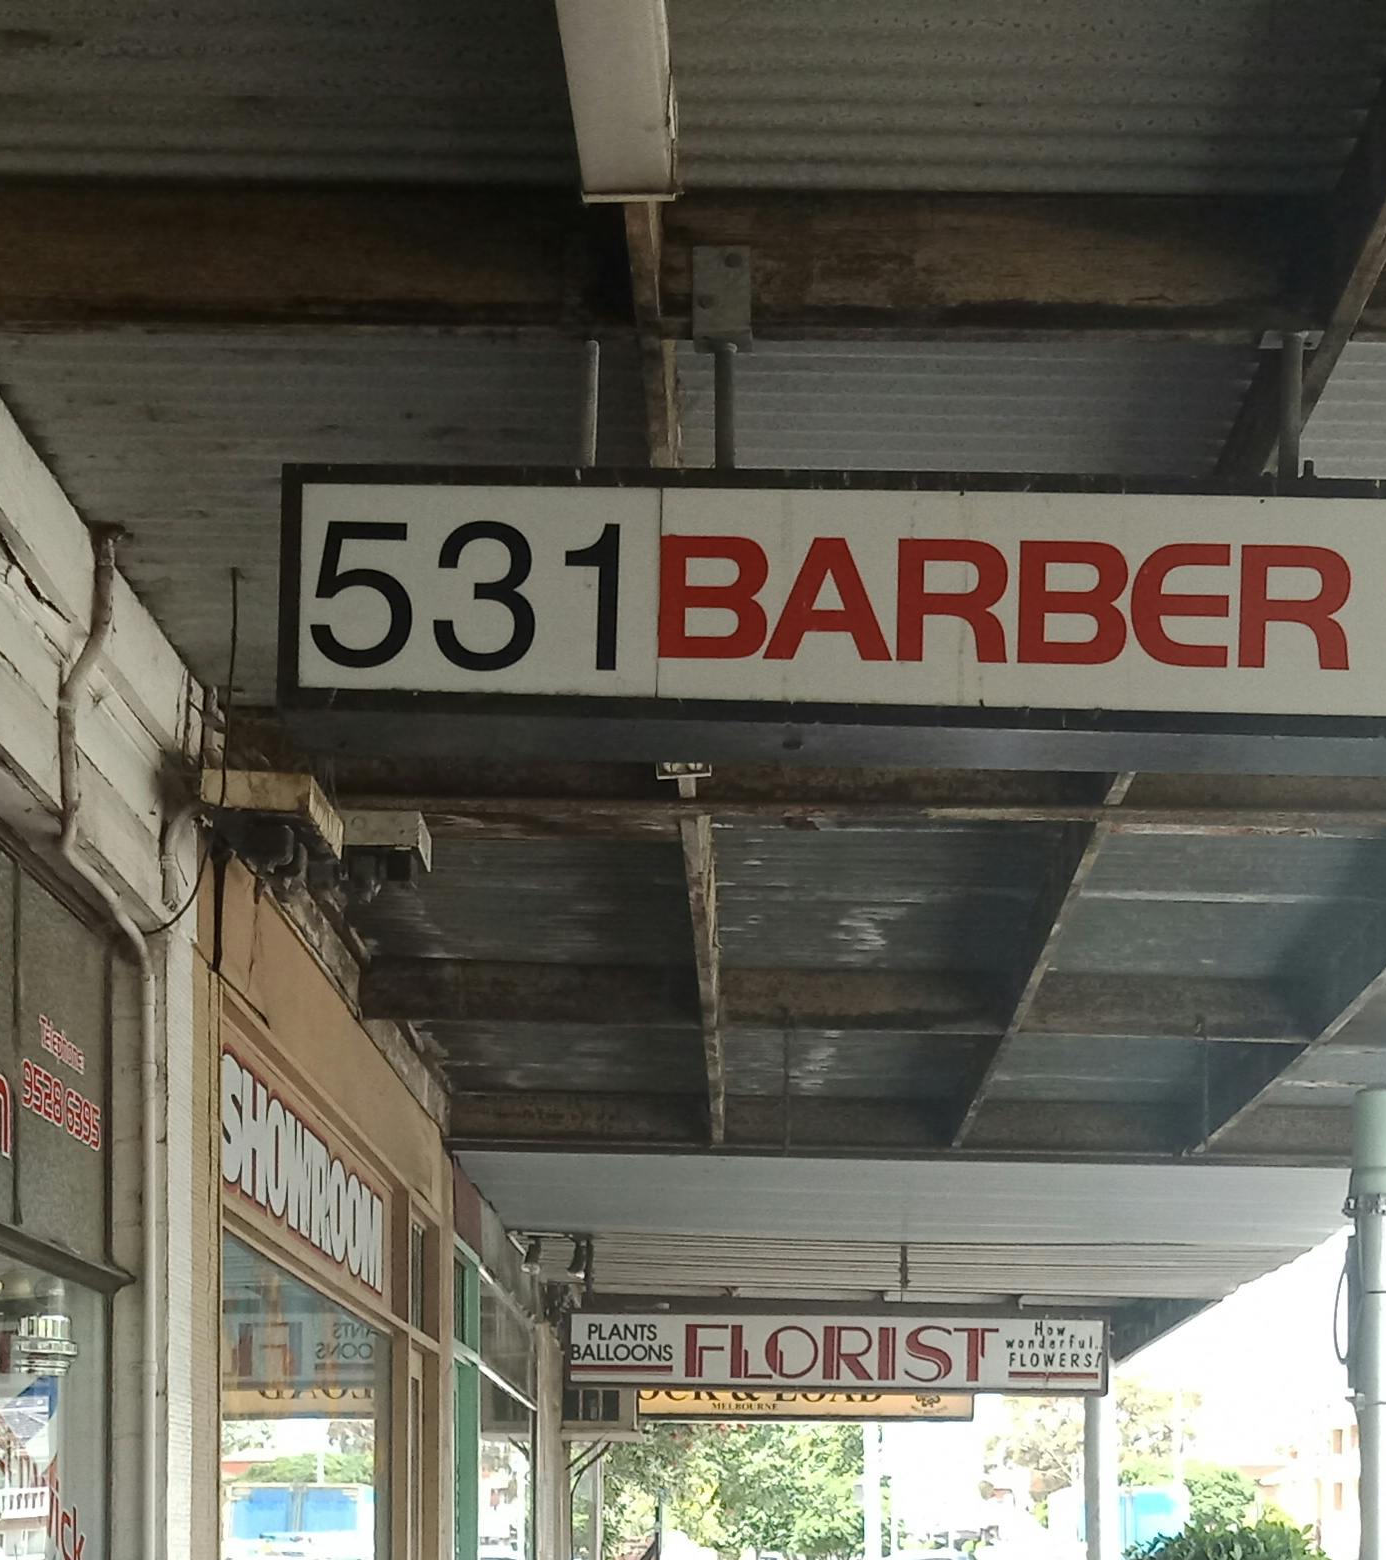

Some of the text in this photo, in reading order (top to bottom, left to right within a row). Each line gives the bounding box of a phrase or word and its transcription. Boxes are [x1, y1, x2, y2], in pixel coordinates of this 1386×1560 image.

[308, 520, 621, 671] 531
[657, 534, 1349, 670] BARBER
[22, 1058, 101, 1151] 9528 6395
[221, 1052, 385, 1294] SHOWROOM
[587, 1323, 657, 1341] PLANTS
[1034, 1320, 1066, 1337] How
[571, 1344, 673, 1362] BALLOONS
[684, 1323, 1000, 1382] FLORIST
[1008, 1352, 1102, 1368] FLOWERS!
[711, 1402, 779, 1412] MELBOURNE
